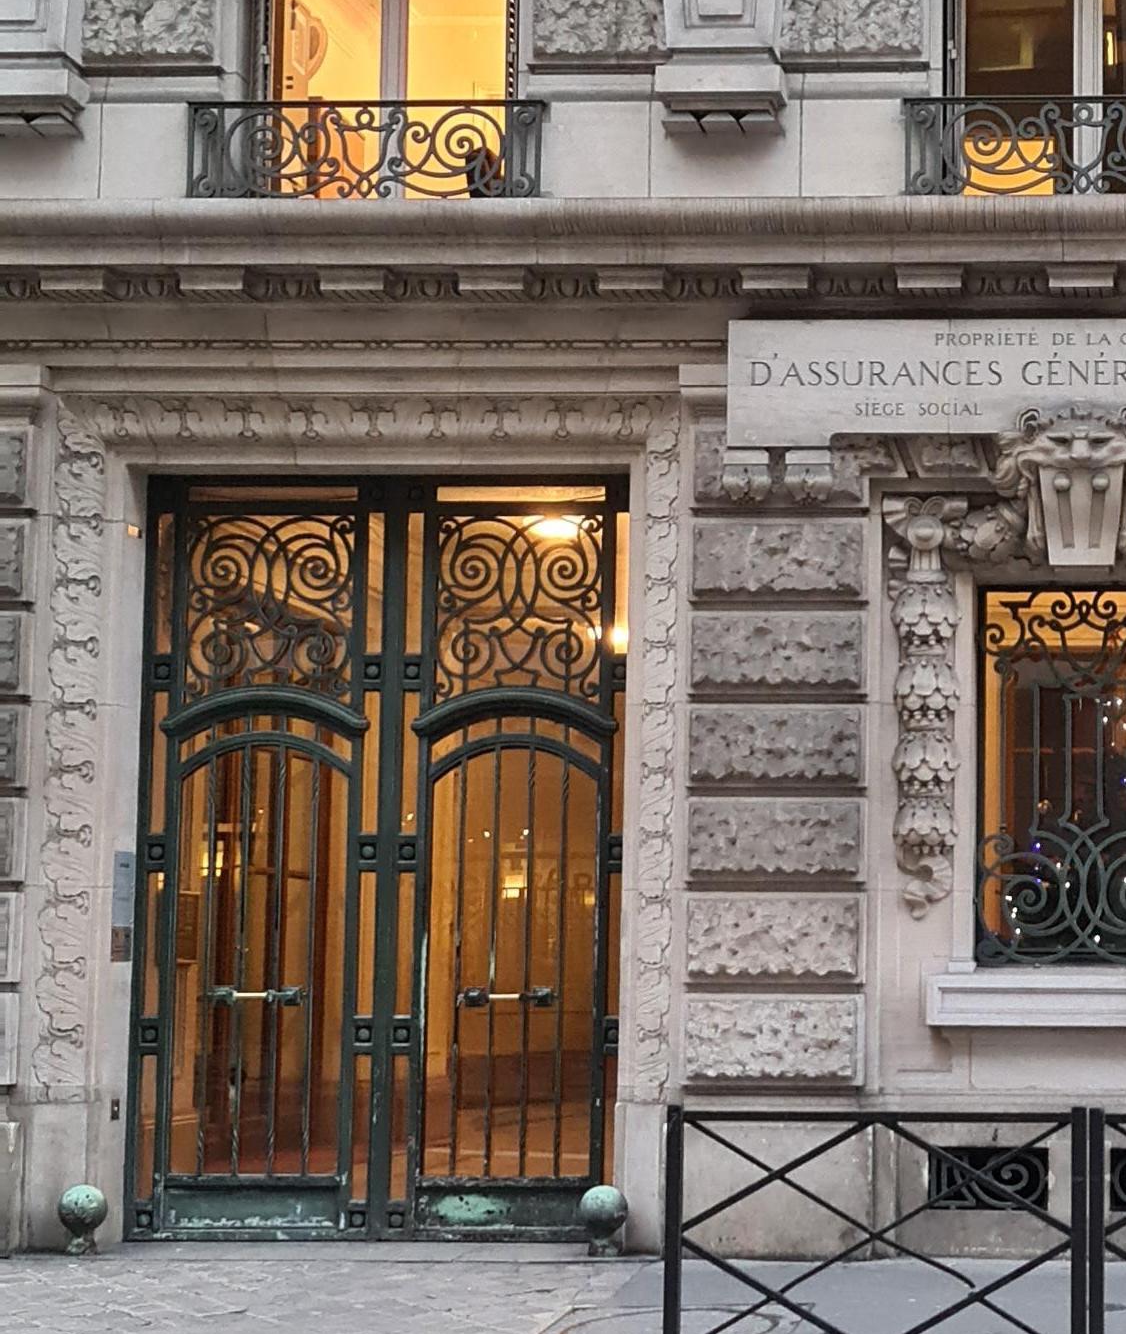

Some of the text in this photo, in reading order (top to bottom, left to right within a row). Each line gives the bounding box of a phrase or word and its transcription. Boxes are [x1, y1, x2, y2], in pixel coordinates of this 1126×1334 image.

[1052, 333, 1076, 346] DE
[1087, 332, 1112, 345] LA
[750, 353, 1003, 386] D'ASSURANCES
[918, 397, 984, 416] SOCIAL
